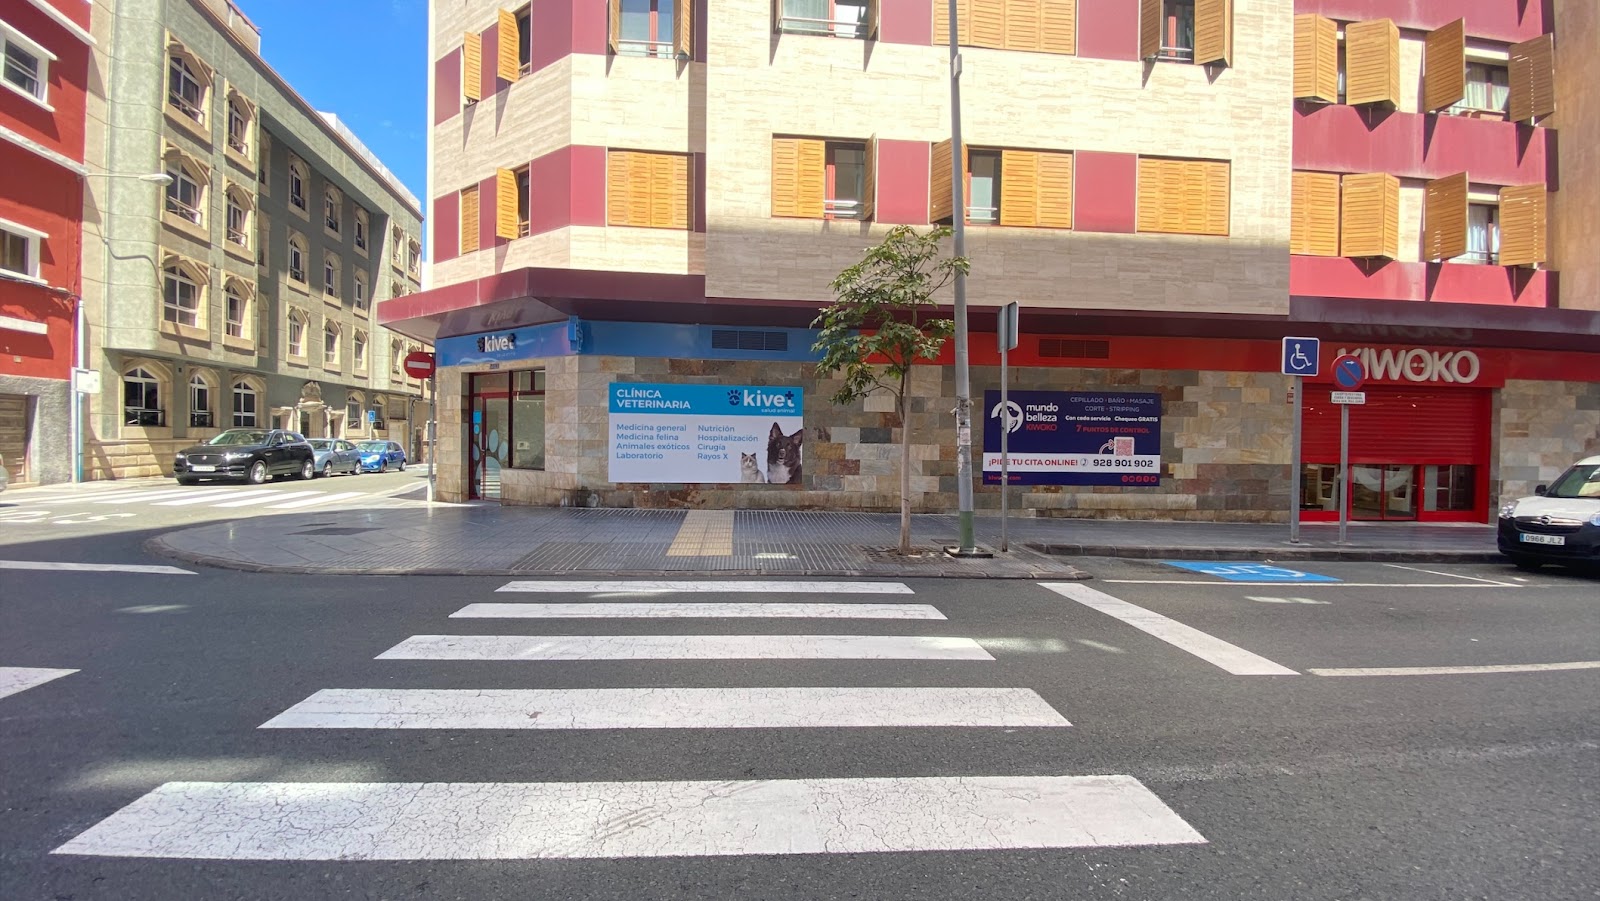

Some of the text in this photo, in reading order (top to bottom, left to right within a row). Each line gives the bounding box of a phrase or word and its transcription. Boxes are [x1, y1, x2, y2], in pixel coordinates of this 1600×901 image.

[484, 333, 516, 353] kivet
[616, 388, 662, 399] CLÍNICA
[743, 389, 795, 408] kivet
[1070, 396, 1104, 404] CEPILLADO
[1107, 396, 1126, 404] BAÑO
[616, 400, 691, 409] VETERINARIA
[1026, 402, 1059, 412] mundo
[1025, 412, 1058, 422] belleza
[656, 424, 687, 433] general
[1025, 423, 1058, 431] KIWOKO
[1076, 424, 1082, 432] 7
[697, 434, 759, 443] Hospitalización
[697, 443, 726, 452] Cirugía
[697, 452, 721, 461] Rayos
[1012, 458, 1023, 466] TU
[1093, 459, 1154, 468] 928 901 902
[1526, 535, 1544, 543] 0966
